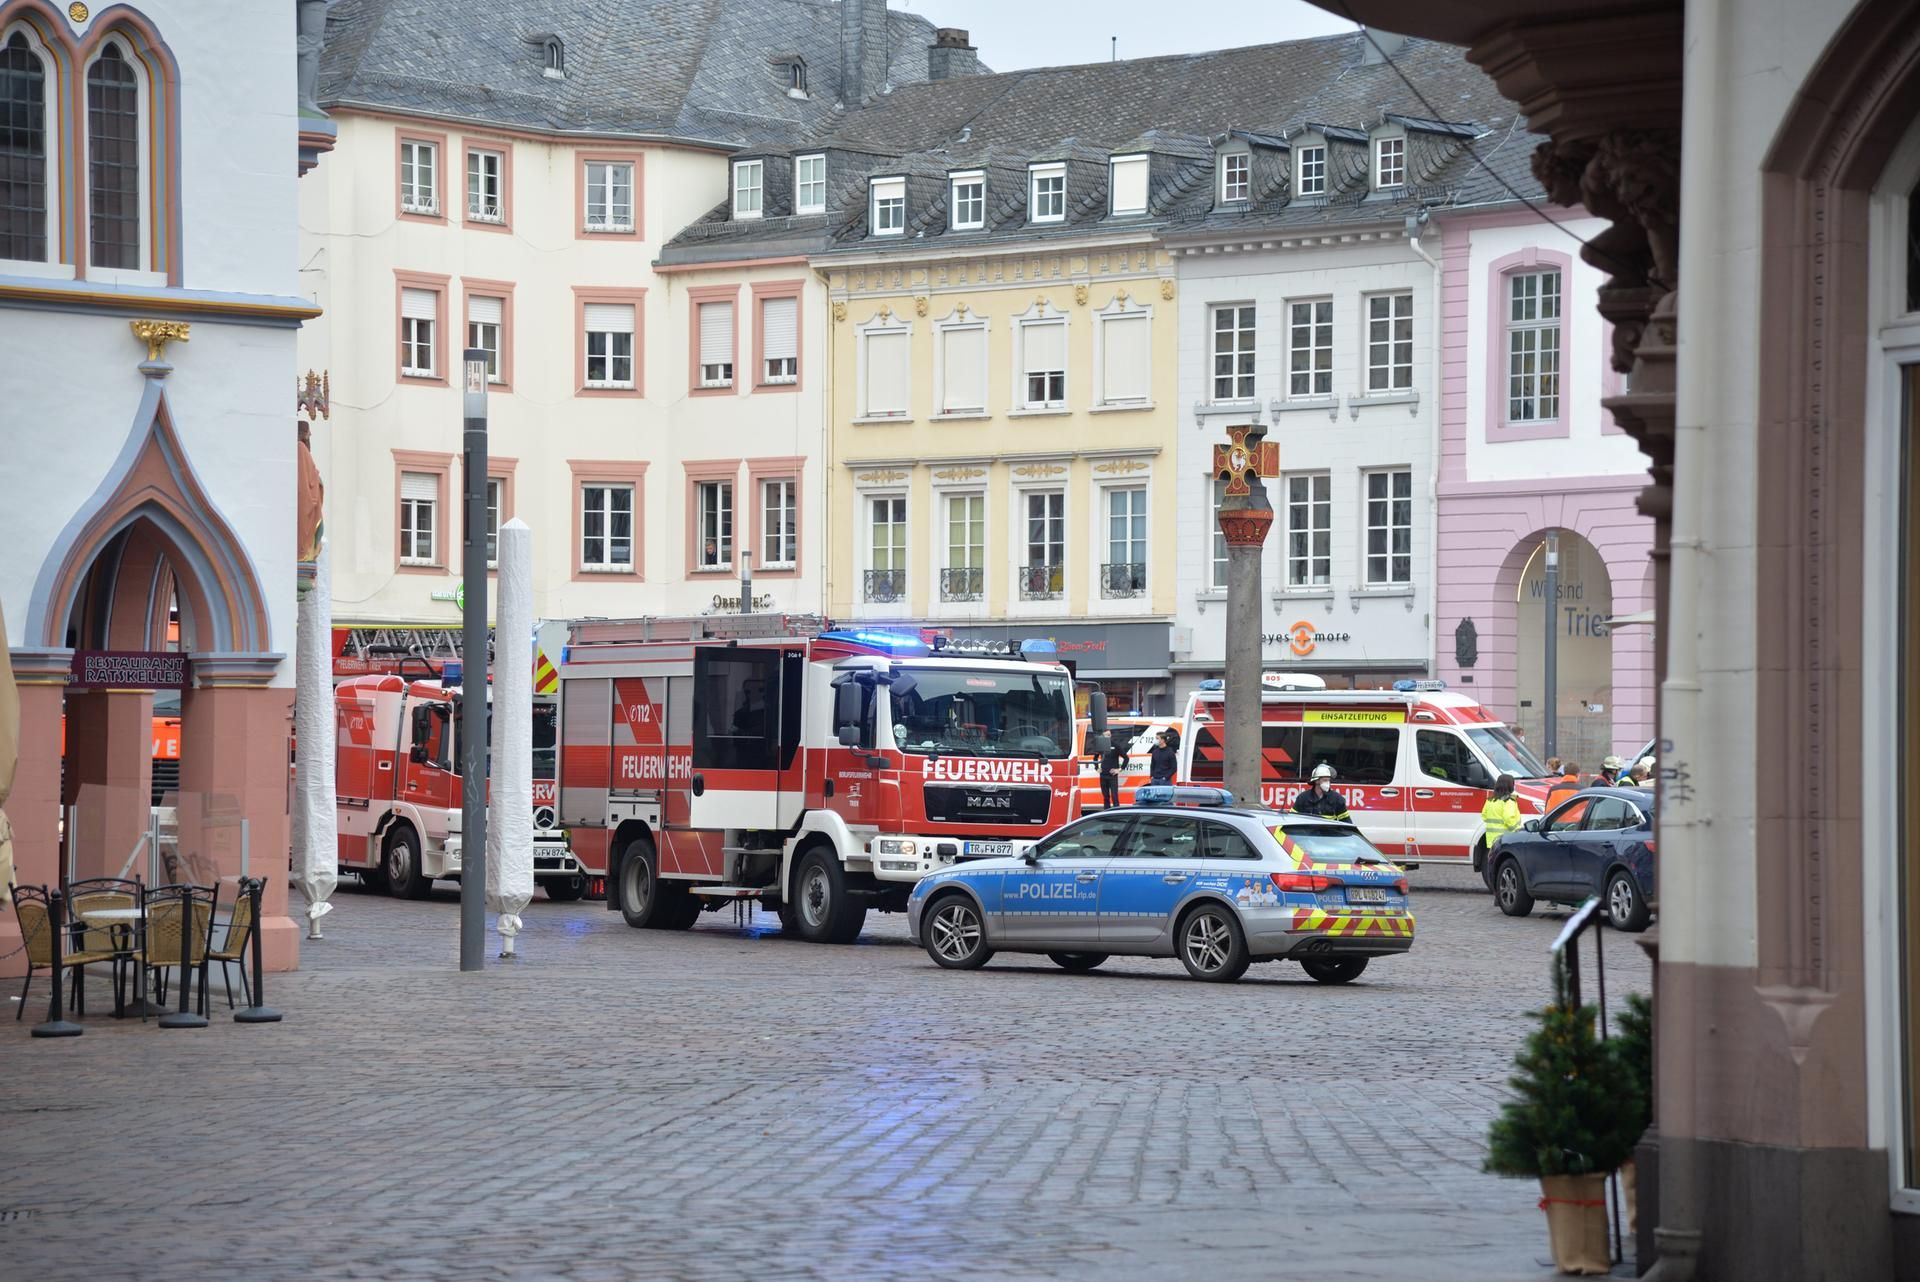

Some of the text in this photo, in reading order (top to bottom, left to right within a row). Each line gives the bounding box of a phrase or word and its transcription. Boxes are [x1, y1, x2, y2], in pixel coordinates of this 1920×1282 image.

[1314, 632, 1350, 642] more
[85, 656, 184, 670] RESTAURANT
[85, 669, 184, 683] RATSKELLER
[637, 704, 650, 723] 112
[1321, 712, 1388, 721] EINSATZLEITUNG
[622, 755, 692, 779] FEUERWEHR
[922, 759, 1053, 783] FEUERWEHR
[966, 797, 1010, 808] MAN
[551, 849, 565, 857] 874
[970, 843, 980, 853] TR
[996, 845, 1012, 854] 877
[1317, 894, 1344, 903] POLIZEI
